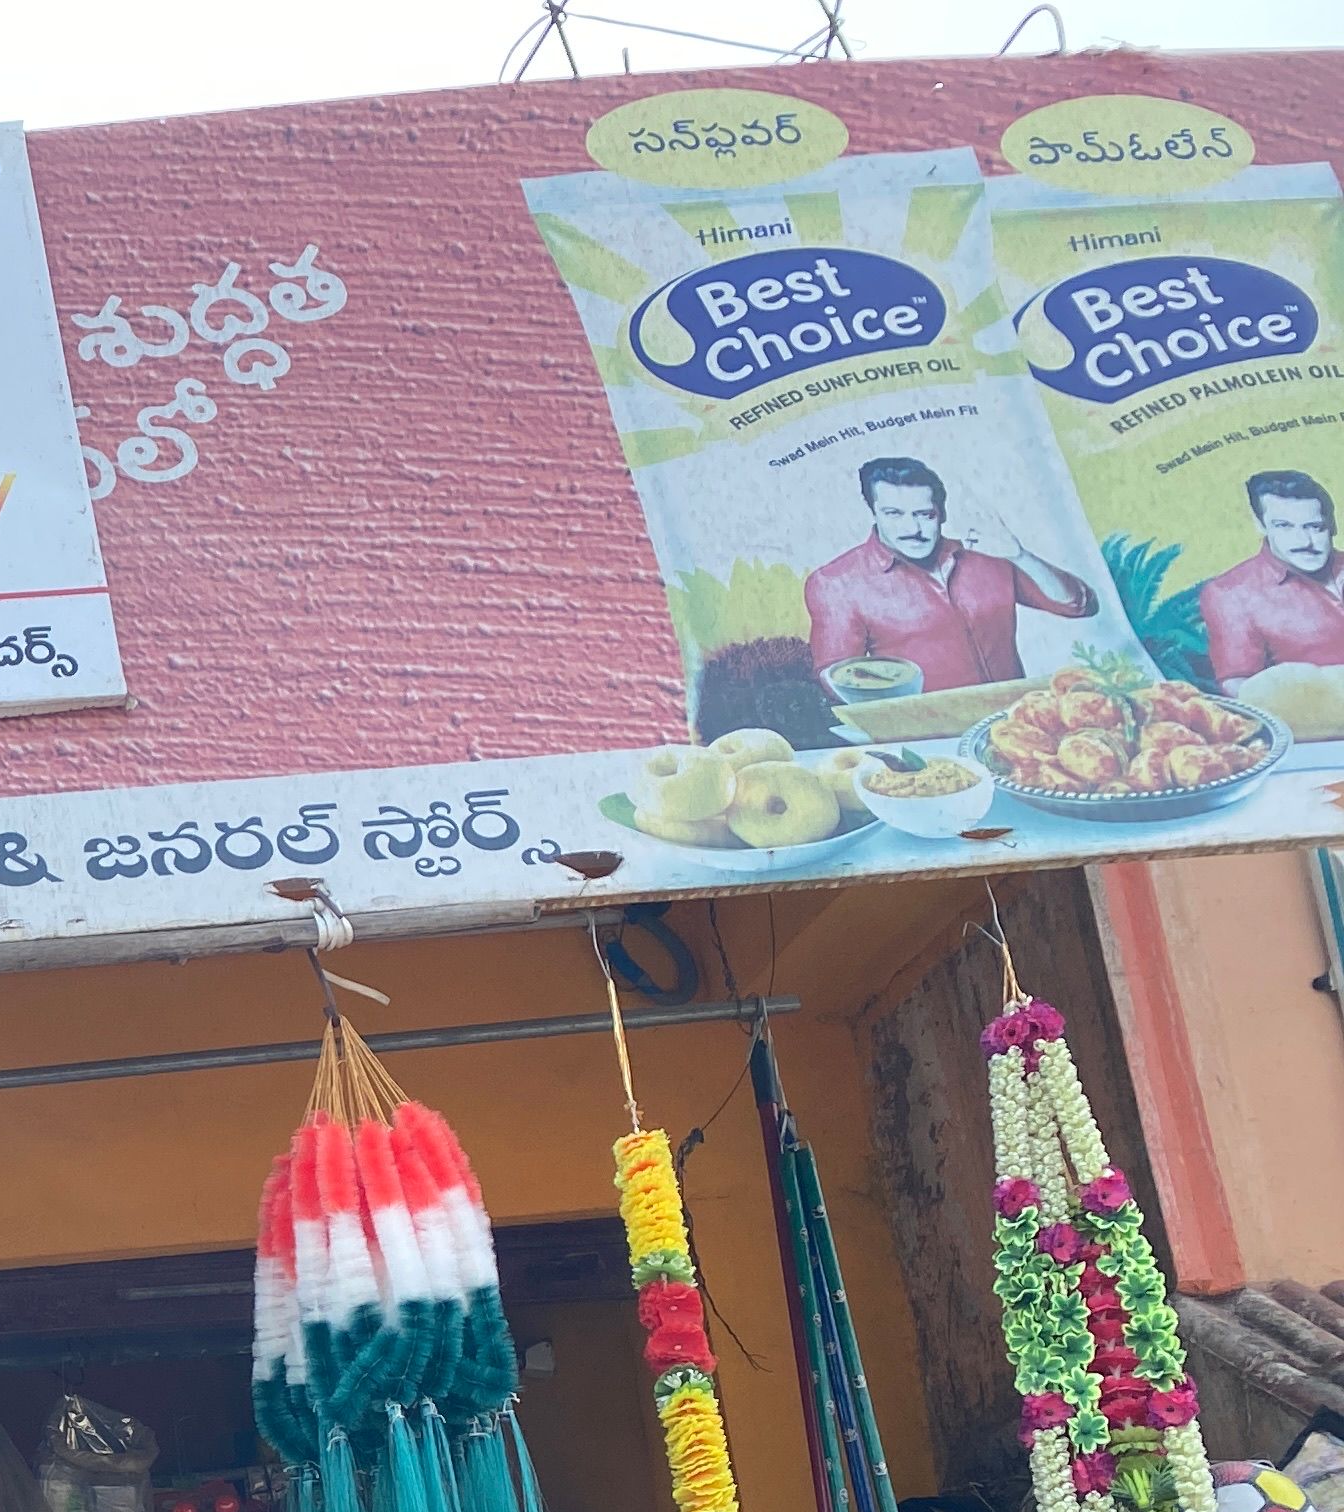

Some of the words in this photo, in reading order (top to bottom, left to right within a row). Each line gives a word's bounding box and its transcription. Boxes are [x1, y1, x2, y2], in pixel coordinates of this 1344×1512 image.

[695, 216, 794, 248] Himani
[1068, 225, 1163, 253] Himani
[694, 257, 851, 327] Best
[1071, 264, 1225, 335] Best
[704, 300, 924, 384] Choice
[1083, 303, 1300, 390] Choice
[728, 389, 804, 430] REFINED
[804, 361, 923, 398] SUNFLOWER
[926, 357, 961, 373] OIL
[1110, 392, 1187, 434] REFINED
[1189, 366, 1303, 400] PALMOLEIN
[1308, 364, 1344, 380] OIL
[768, 446, 806, 469] Swad
[865, 412, 919, 433] Budget
[920, 407, 956, 421] Mein
[1155, 447, 1192, 475] Swad
[1248, 419, 1300, 438] Budget
[81, 801, 342, 882] జనరల్
